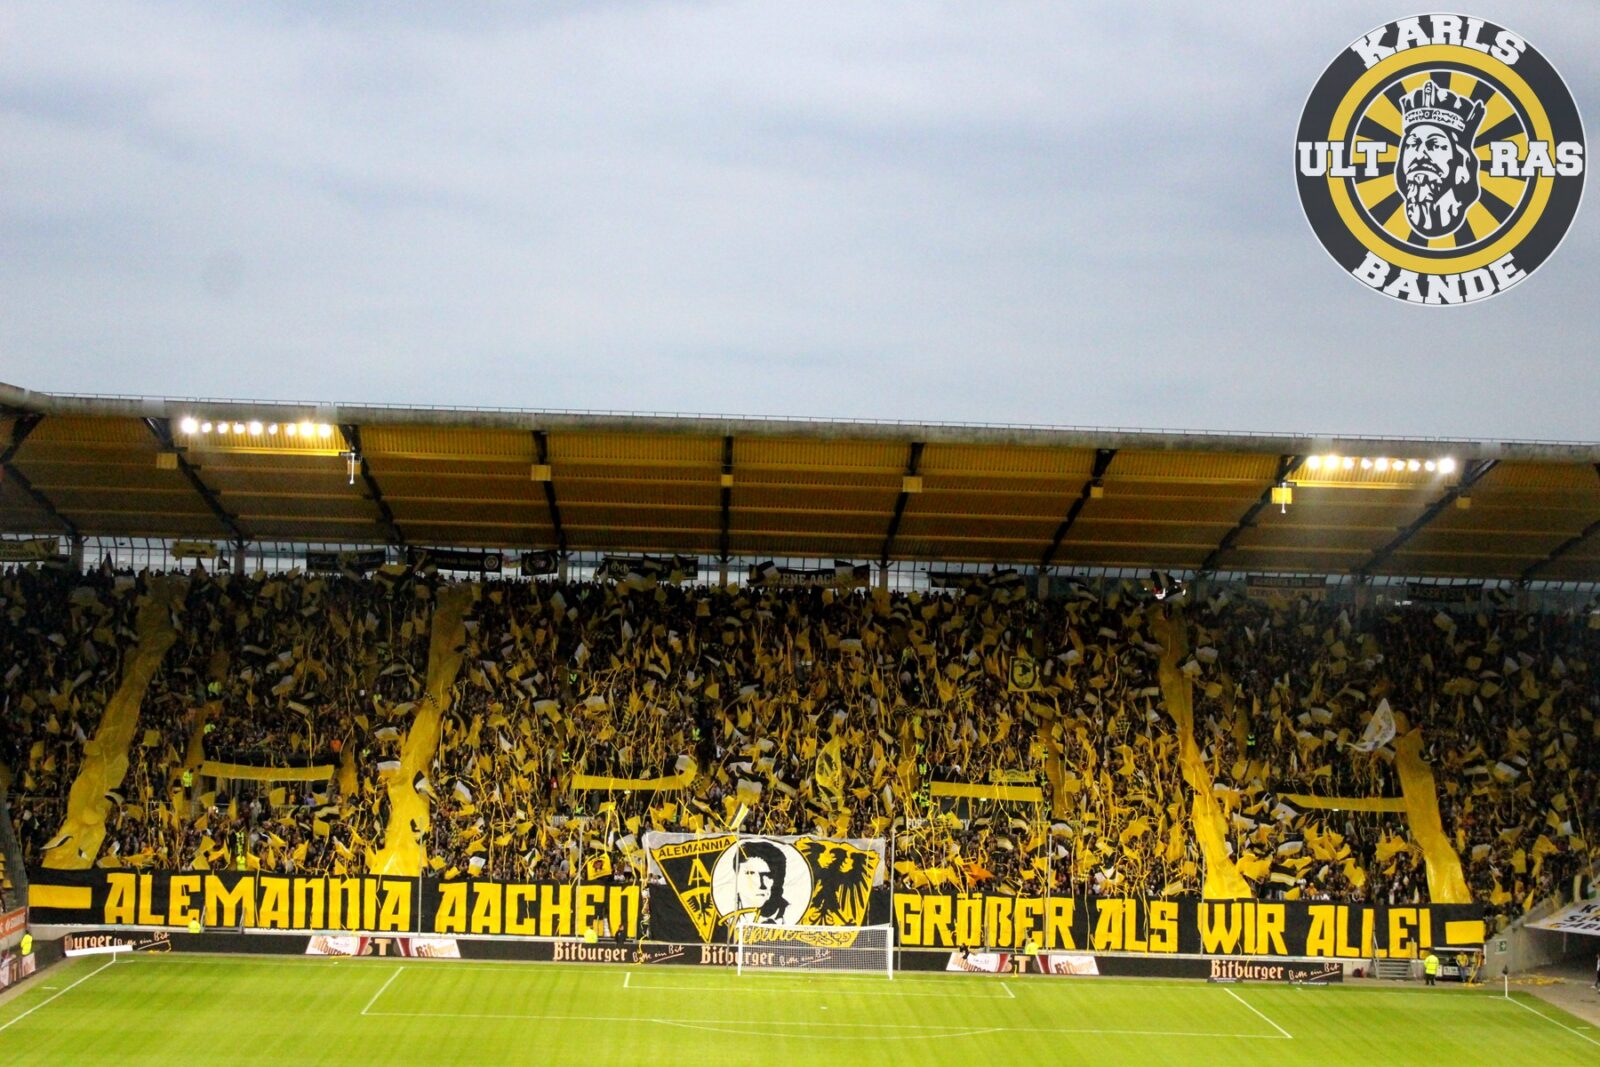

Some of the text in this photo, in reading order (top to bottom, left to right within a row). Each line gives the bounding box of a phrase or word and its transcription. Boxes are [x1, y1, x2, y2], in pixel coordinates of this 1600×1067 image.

[659, 838, 731, 857] ALEMANNIA
[104, 872, 411, 932] ALEMANNIA
[434, 882, 640, 937] AACHEN
[1094, 898, 1178, 953] ALS
[1197, 902, 1289, 956] WIR
[553, 942, 627, 962] Bitburger
[668, 944, 685, 955] Bit
[1210, 959, 1284, 980] Bitburger
[1323, 963, 1340, 973] Bit
